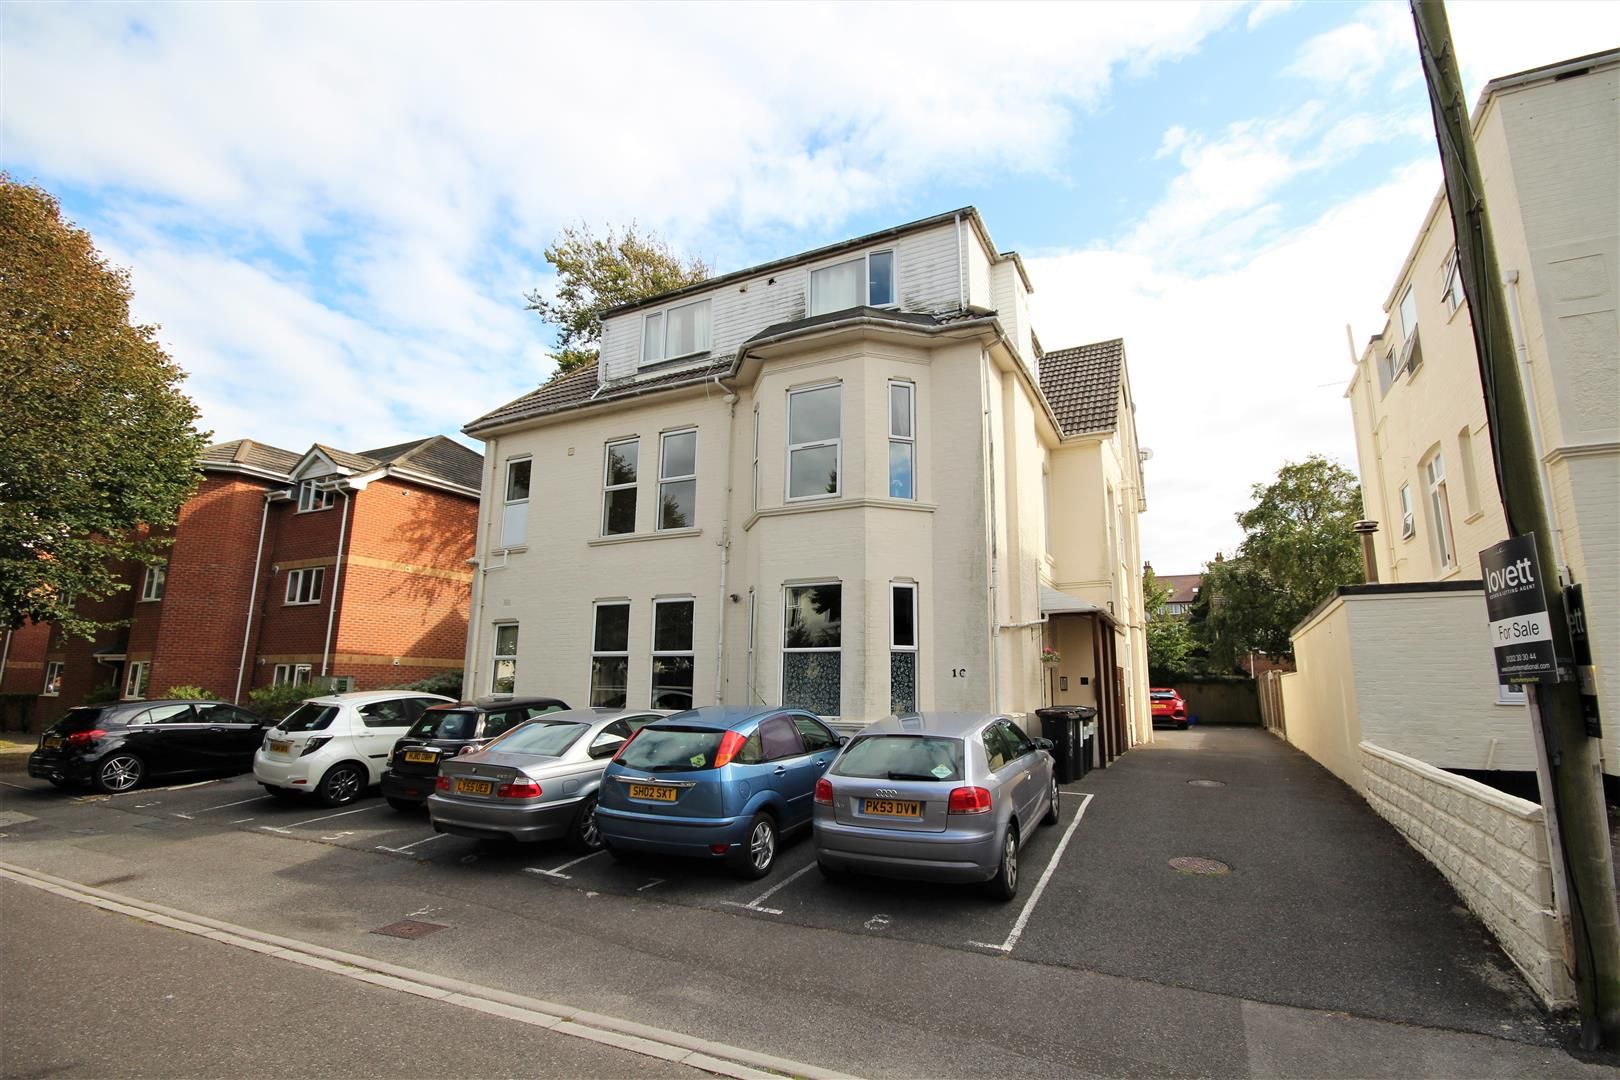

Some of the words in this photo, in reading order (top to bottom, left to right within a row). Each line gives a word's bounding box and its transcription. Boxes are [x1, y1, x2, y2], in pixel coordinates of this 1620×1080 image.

[1485, 557, 1534, 593] lovett
[1520, 583, 1535, 591] AGENT
[1498, 625, 1511, 641] For
[1512, 620, 1539, 638] Sale
[633, 786, 655, 799] SH02
[656, 788, 673, 799] SXT
[865, 800, 894, 814] PK53
[896, 802, 918, 815] DVW
